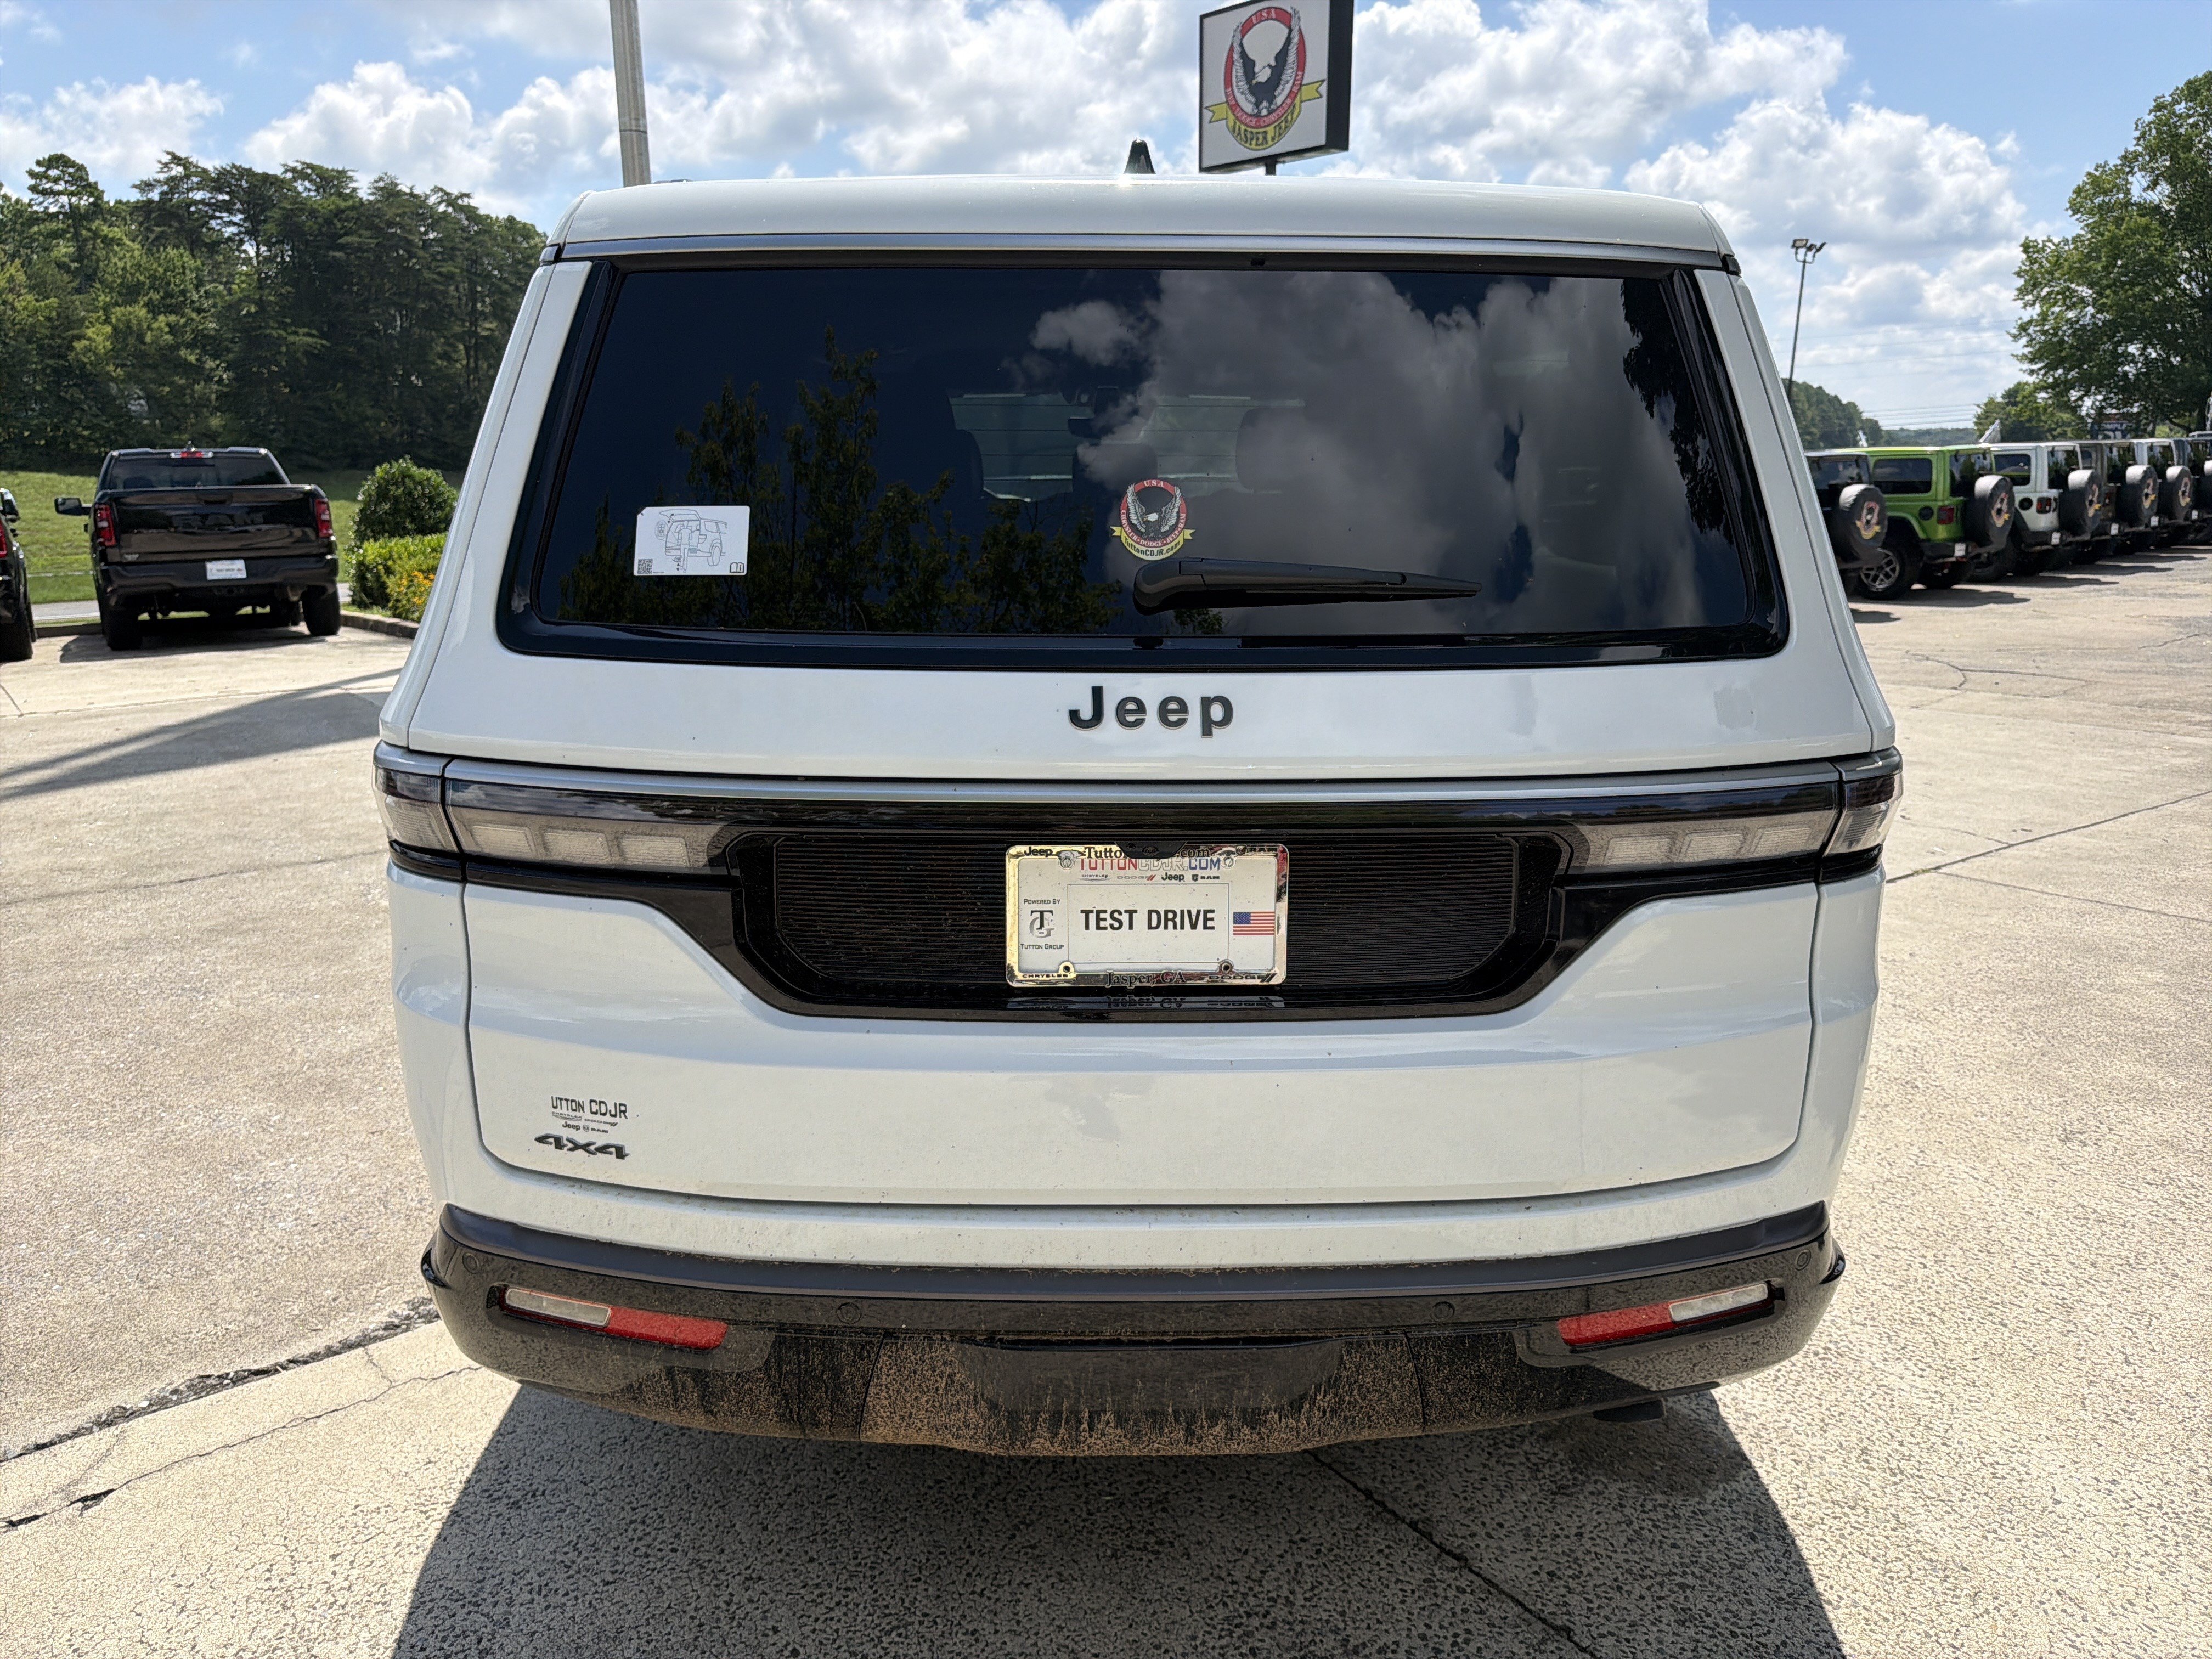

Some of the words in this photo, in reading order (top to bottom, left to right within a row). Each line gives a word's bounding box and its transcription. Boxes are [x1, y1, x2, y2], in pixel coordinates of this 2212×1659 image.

[1252, 8, 1276, 24] USA
[1231, 119, 1268, 146] JASPER
[1271, 103, 1296, 142] JEEP
[1143, 479, 1164, 488] USA
[1120, 510, 1138, 541] CHRYSLER
[1165, 531, 1180, 543] JEEP
[1124, 535, 1180, 557] TuttonCDJR.com
[1068, 685, 1234, 738] Jeep
[1024, 846, 1053, 857] Jeep
[1161, 872, 1185, 882] Jeep
[1080, 909, 1138, 930] TEST
[1147, 909, 1215, 930] DRIVE
[1106, 971, 1156, 988] Jasper,
[1160, 971, 1187, 984] GA
[590, 1099, 628, 1119] CDJR
[562, 1121, 580, 1131] Jeep
